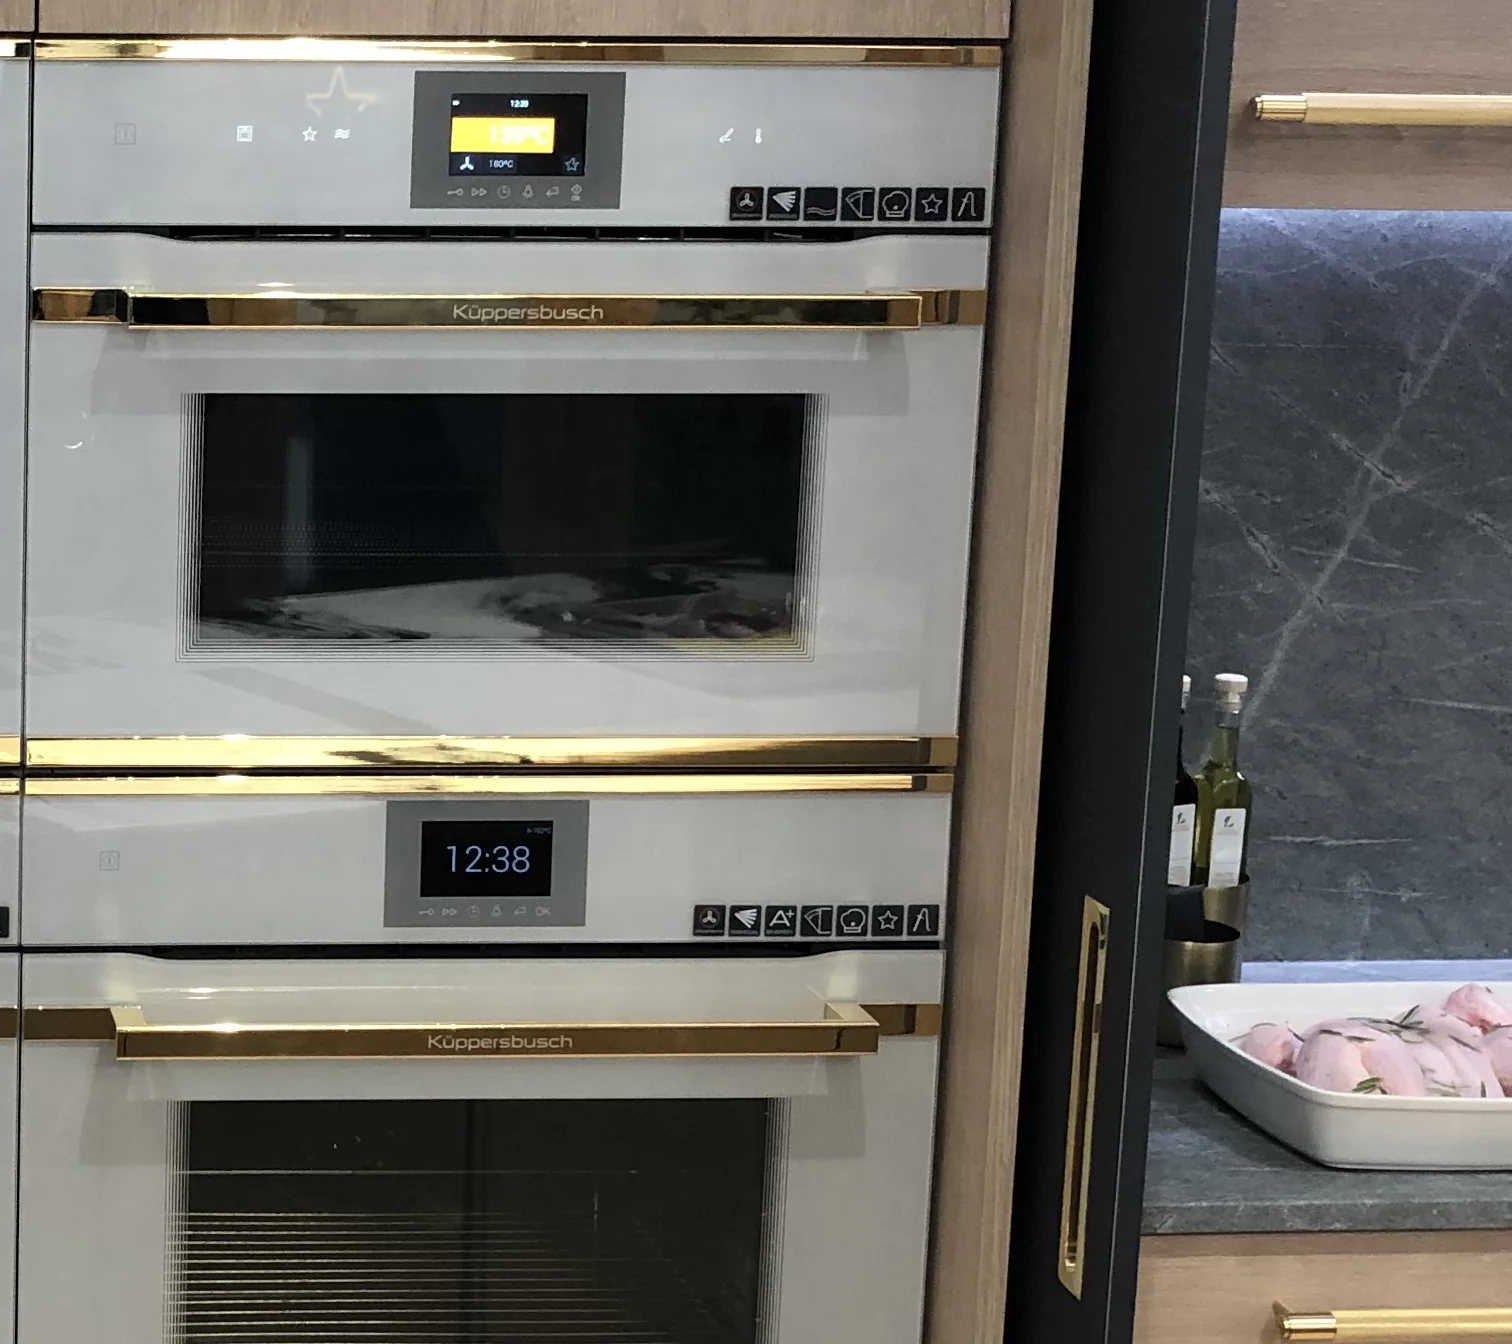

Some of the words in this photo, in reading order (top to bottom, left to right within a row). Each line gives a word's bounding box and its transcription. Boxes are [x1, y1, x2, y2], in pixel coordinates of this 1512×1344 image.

[452, 304, 604, 322] Küppersbusch
[446, 845, 531, 873] 12:38
[535, 907, 551, 916] OK
[427, 1034, 573, 1051] Küppersbusch
